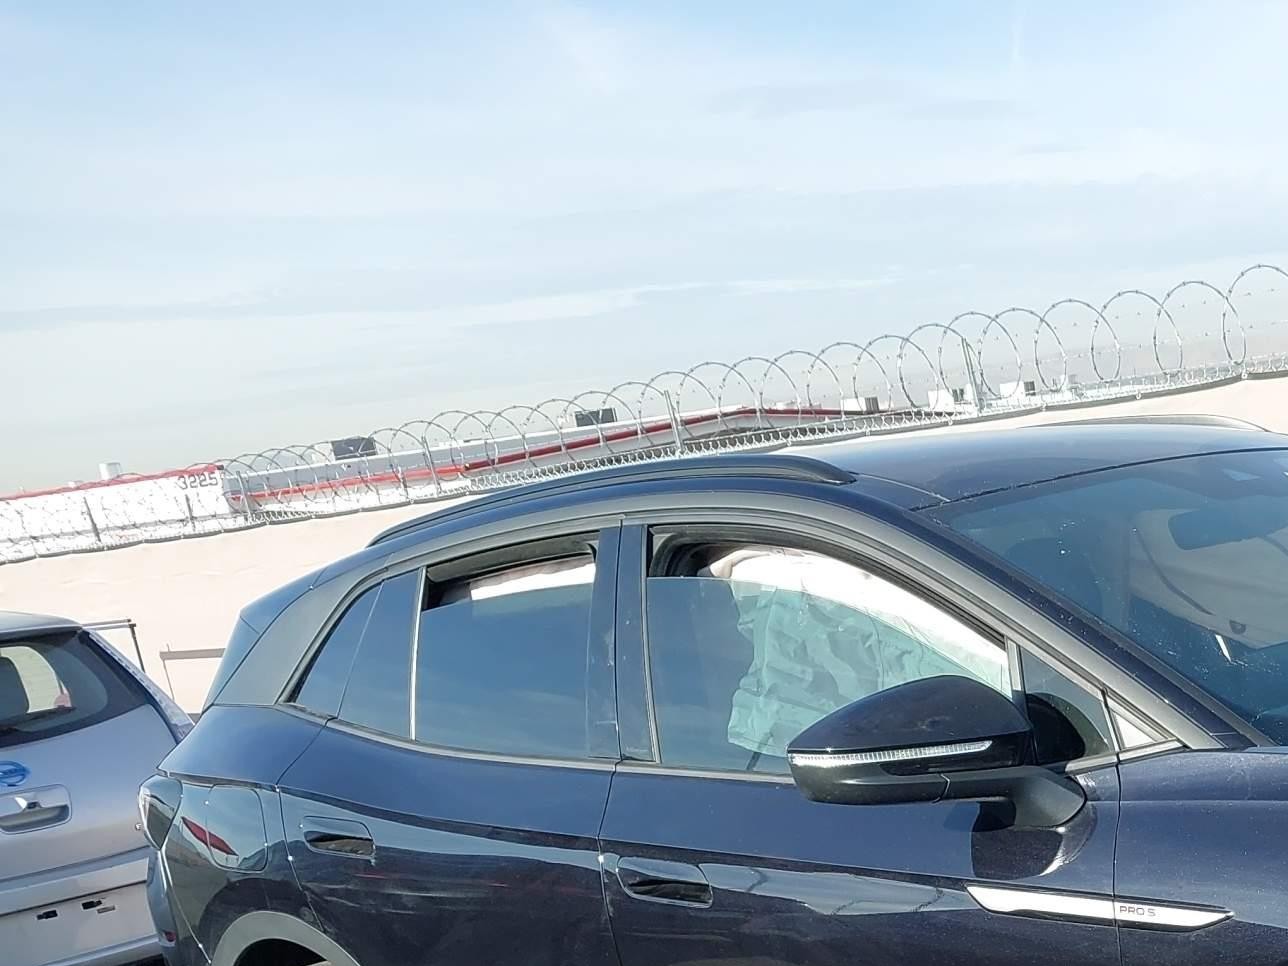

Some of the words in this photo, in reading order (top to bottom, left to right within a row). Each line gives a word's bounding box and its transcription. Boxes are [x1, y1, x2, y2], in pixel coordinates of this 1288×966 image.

[173, 471, 217, 489] 3225
[1119, 905, 1145, 917] PRO
[1147, 908, 1157, 917] S
